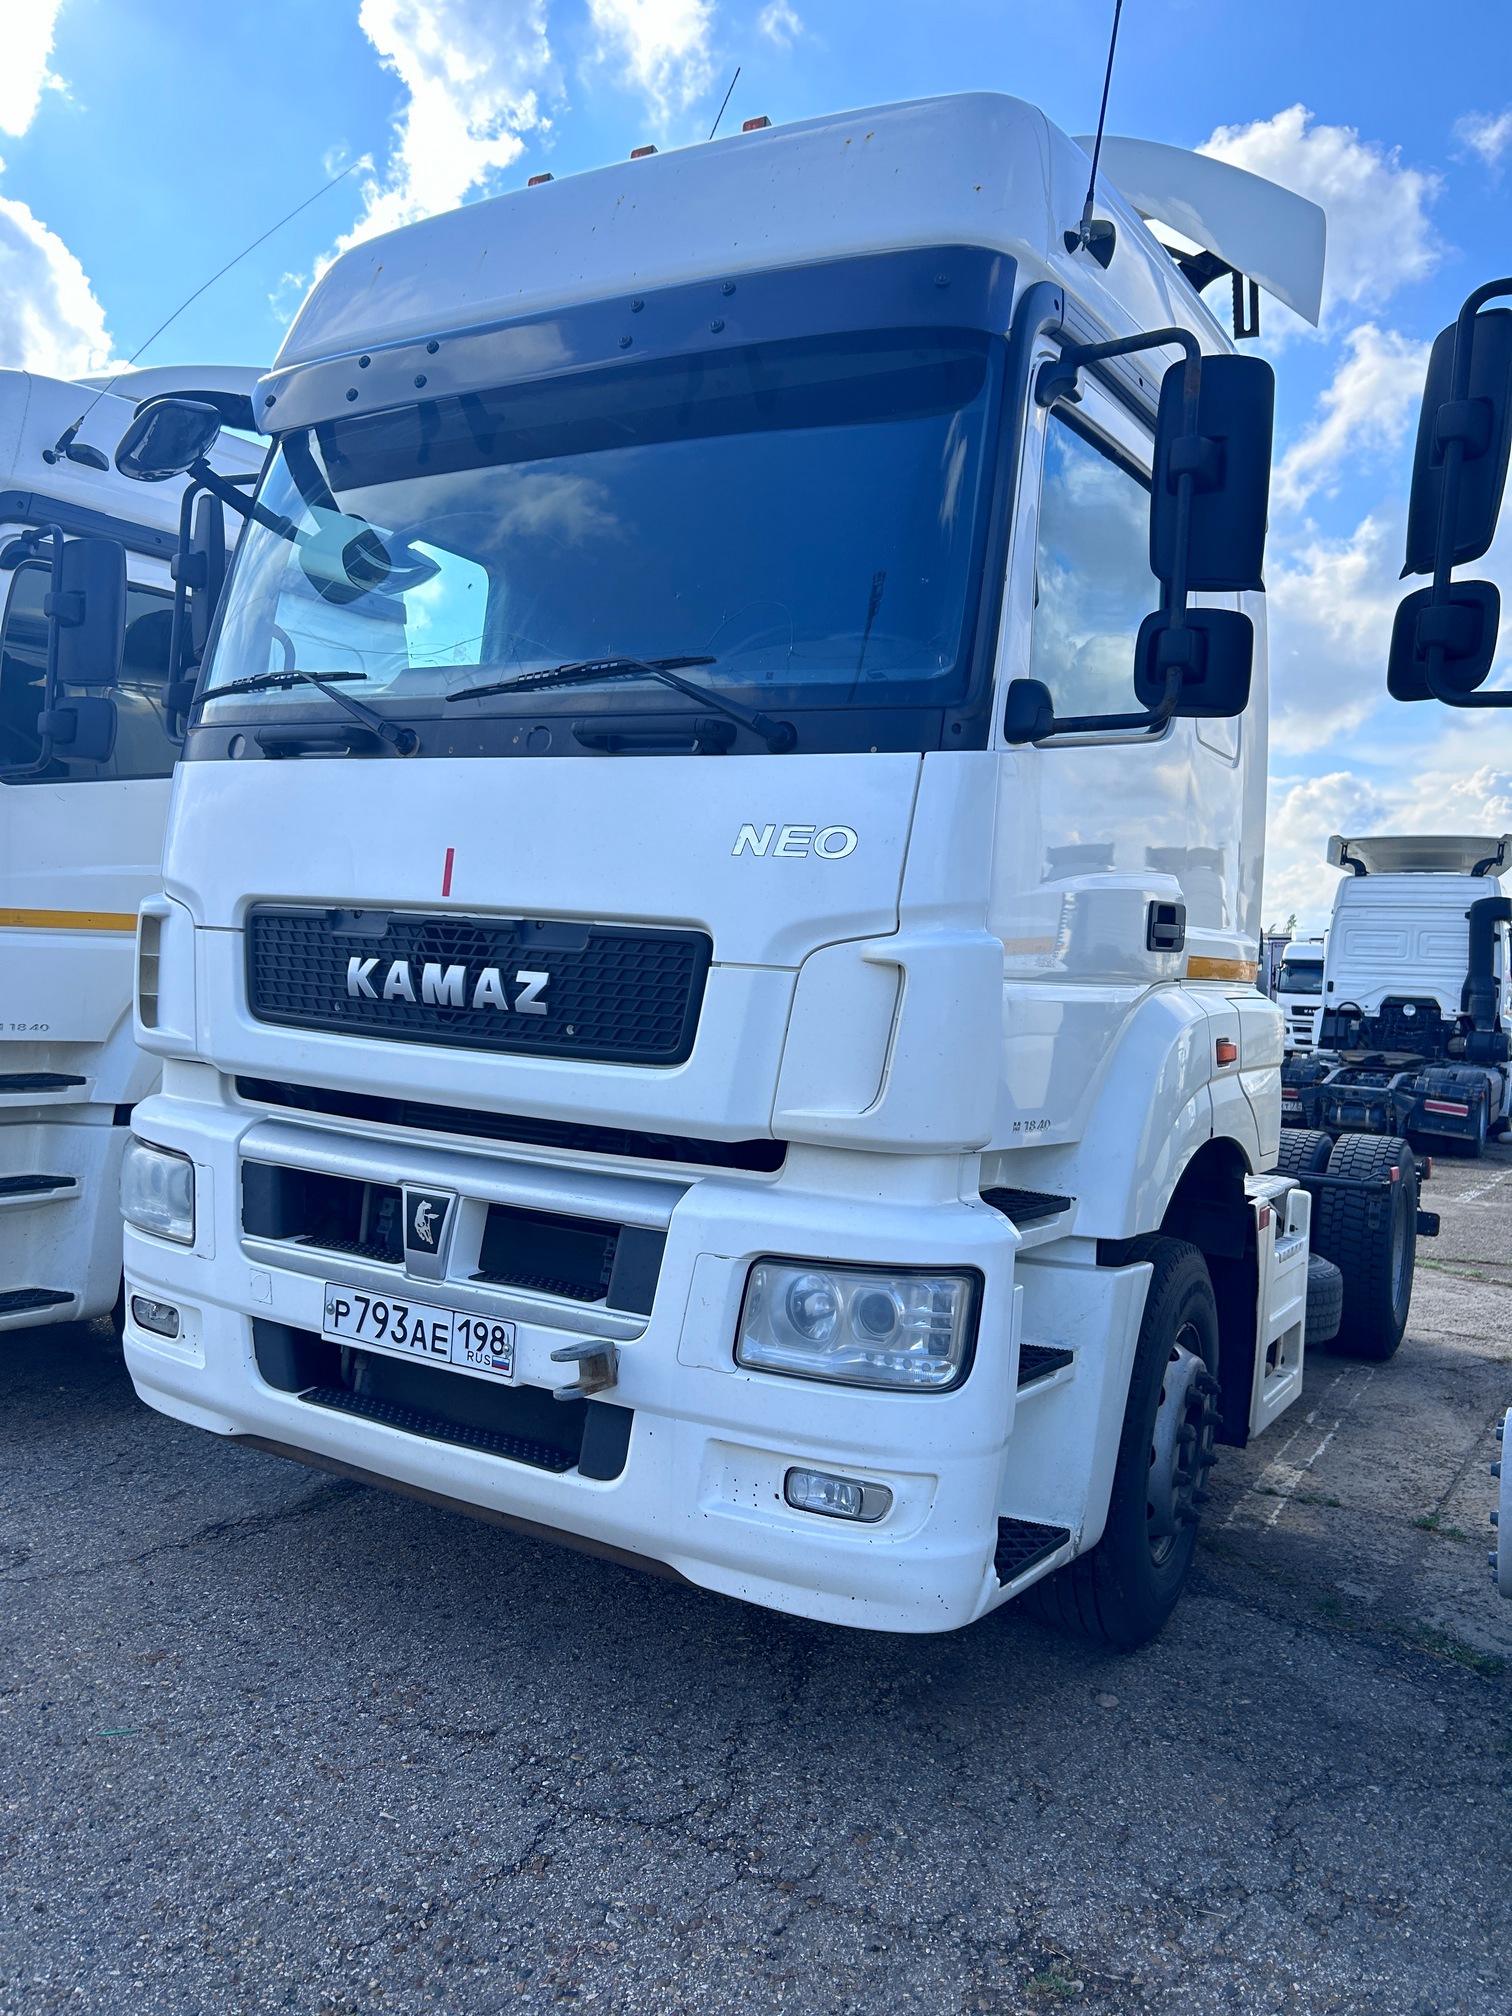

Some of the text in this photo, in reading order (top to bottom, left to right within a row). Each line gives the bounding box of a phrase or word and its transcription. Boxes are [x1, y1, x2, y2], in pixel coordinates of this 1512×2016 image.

[731, 823, 858, 860] NEO
[347, 956, 550, 1015] KAMAZ
[10, 1023, 49, 1031] 1840
[457, 1318, 505, 1356] 198
[467, 1350, 491, 1366] RUS
